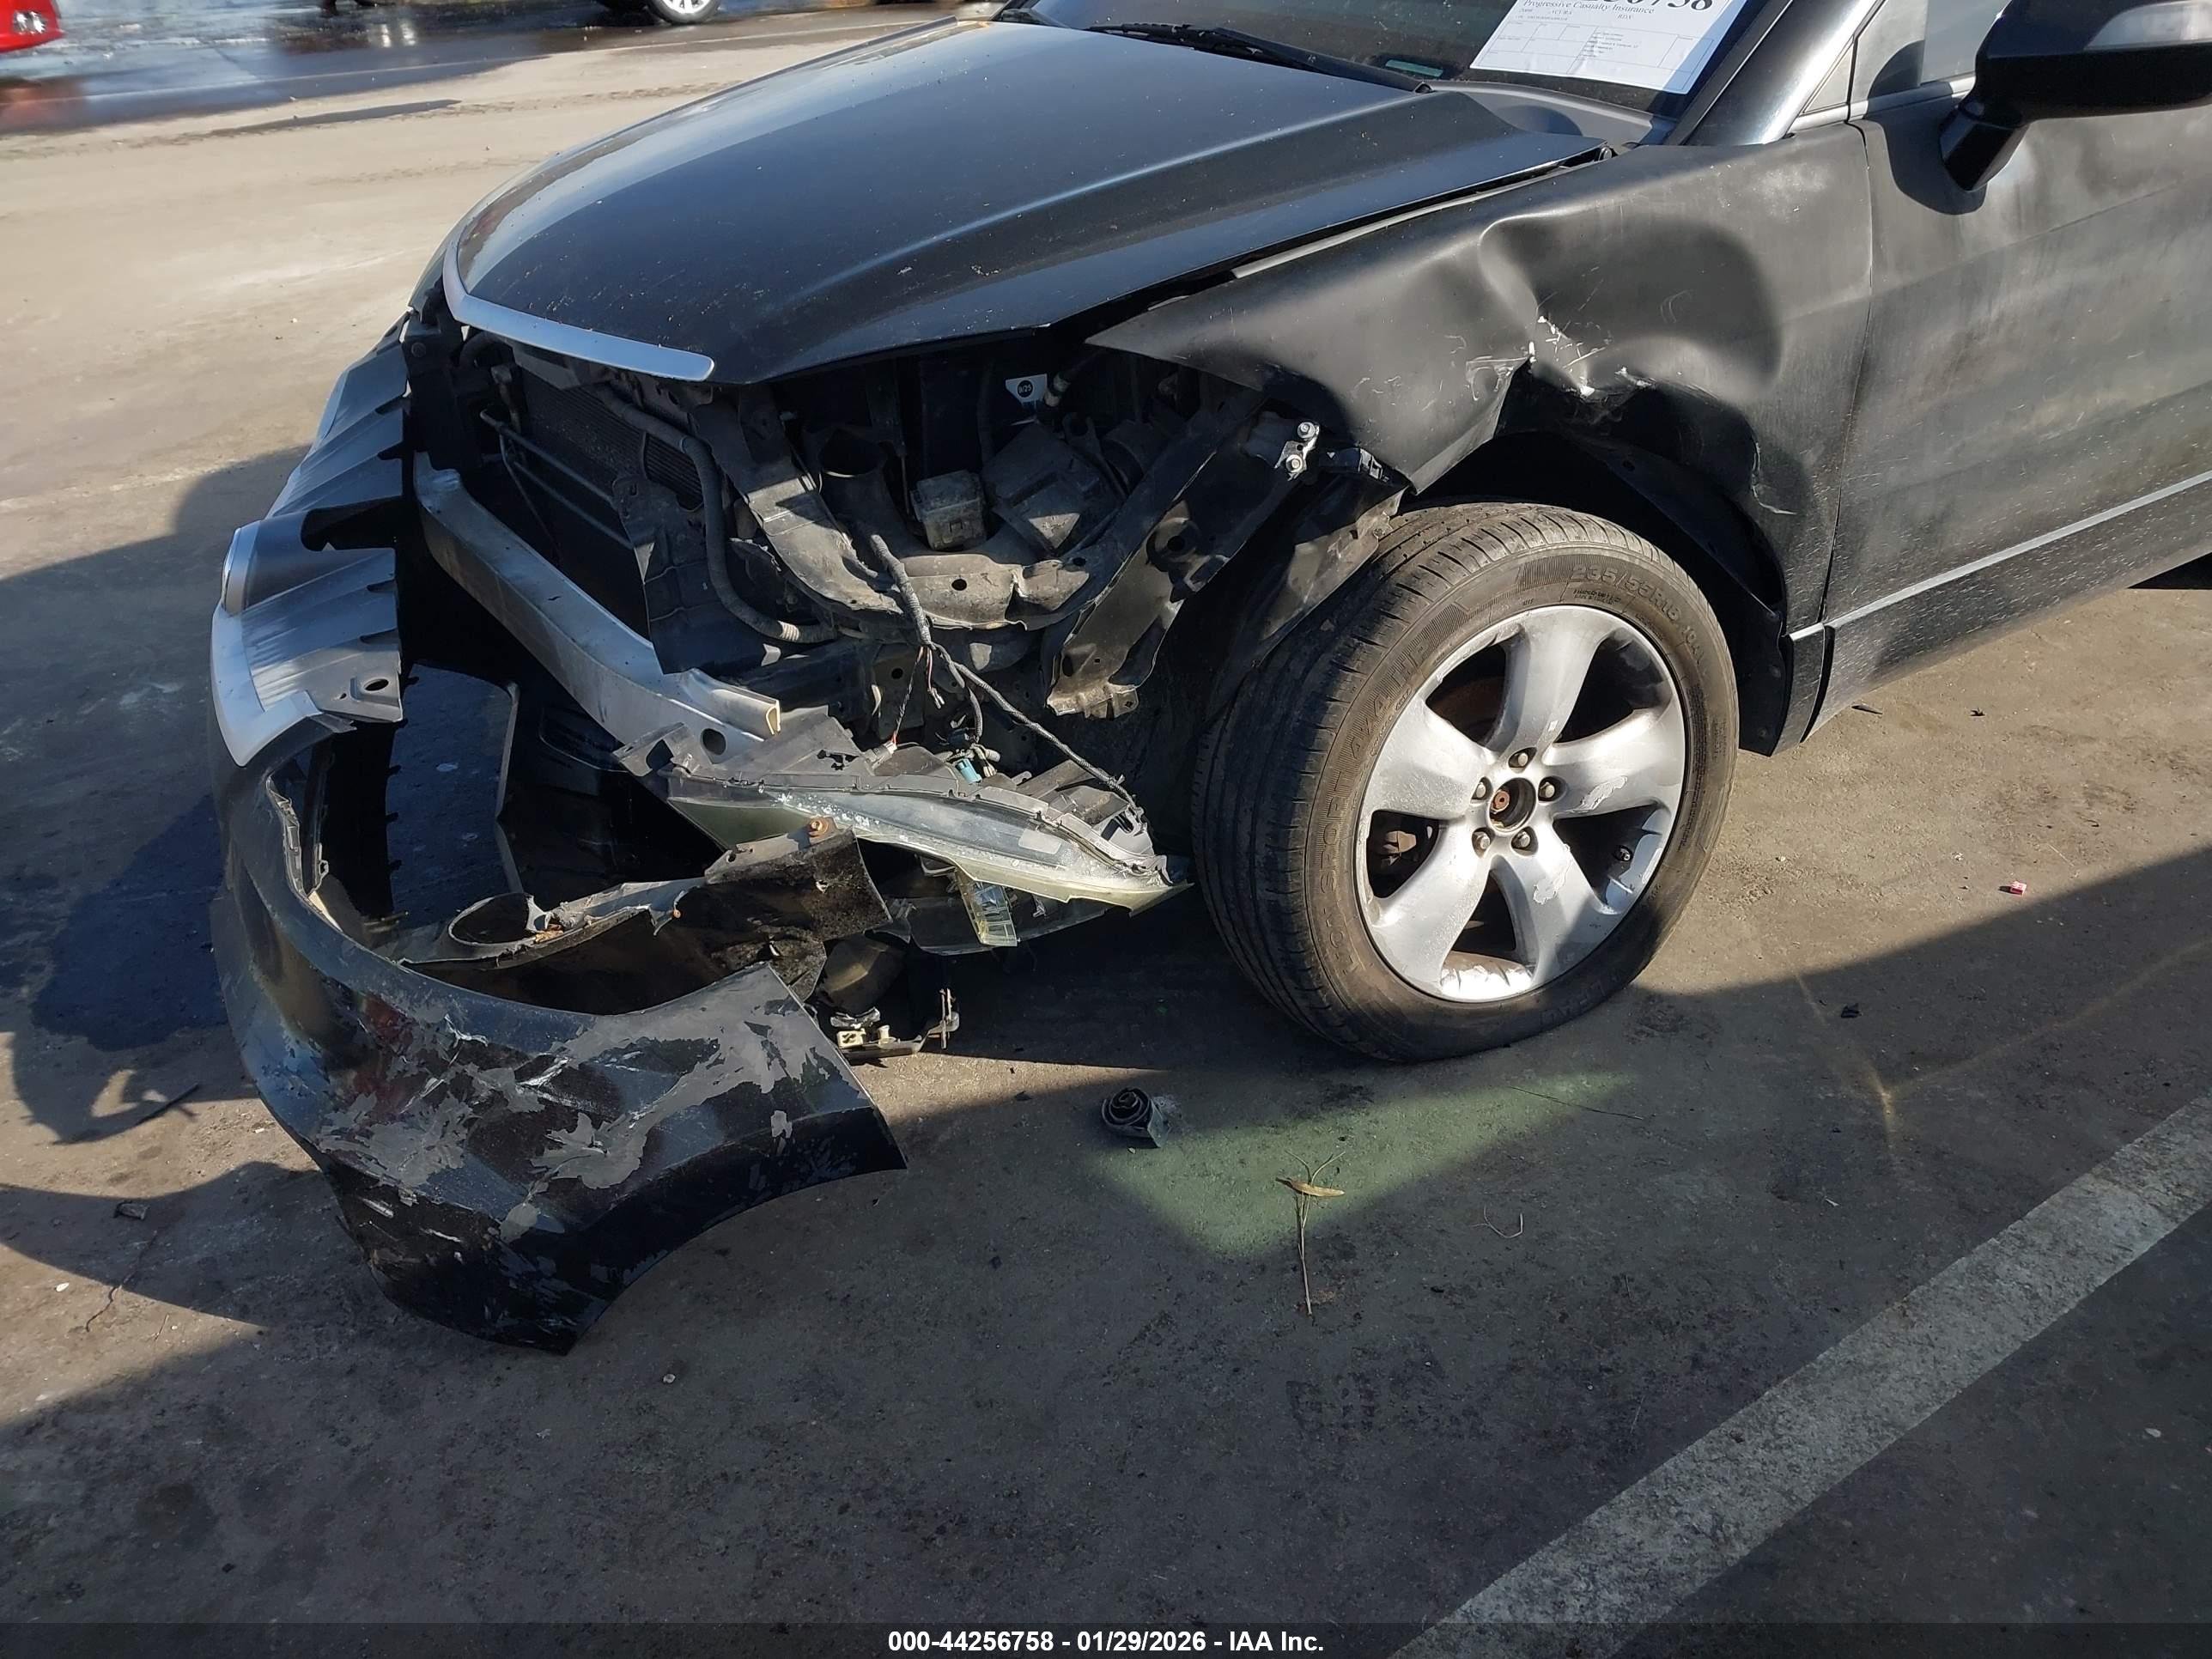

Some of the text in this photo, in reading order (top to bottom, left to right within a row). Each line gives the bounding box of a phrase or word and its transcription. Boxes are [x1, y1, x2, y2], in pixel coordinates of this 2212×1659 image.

[1523, 0, 1571, 9] Progressive
[1572, 1, 1609, 11] Casualty
[1613, 4, 1655, 14] Insurance
[1320, 771, 1351, 894] SPORT
